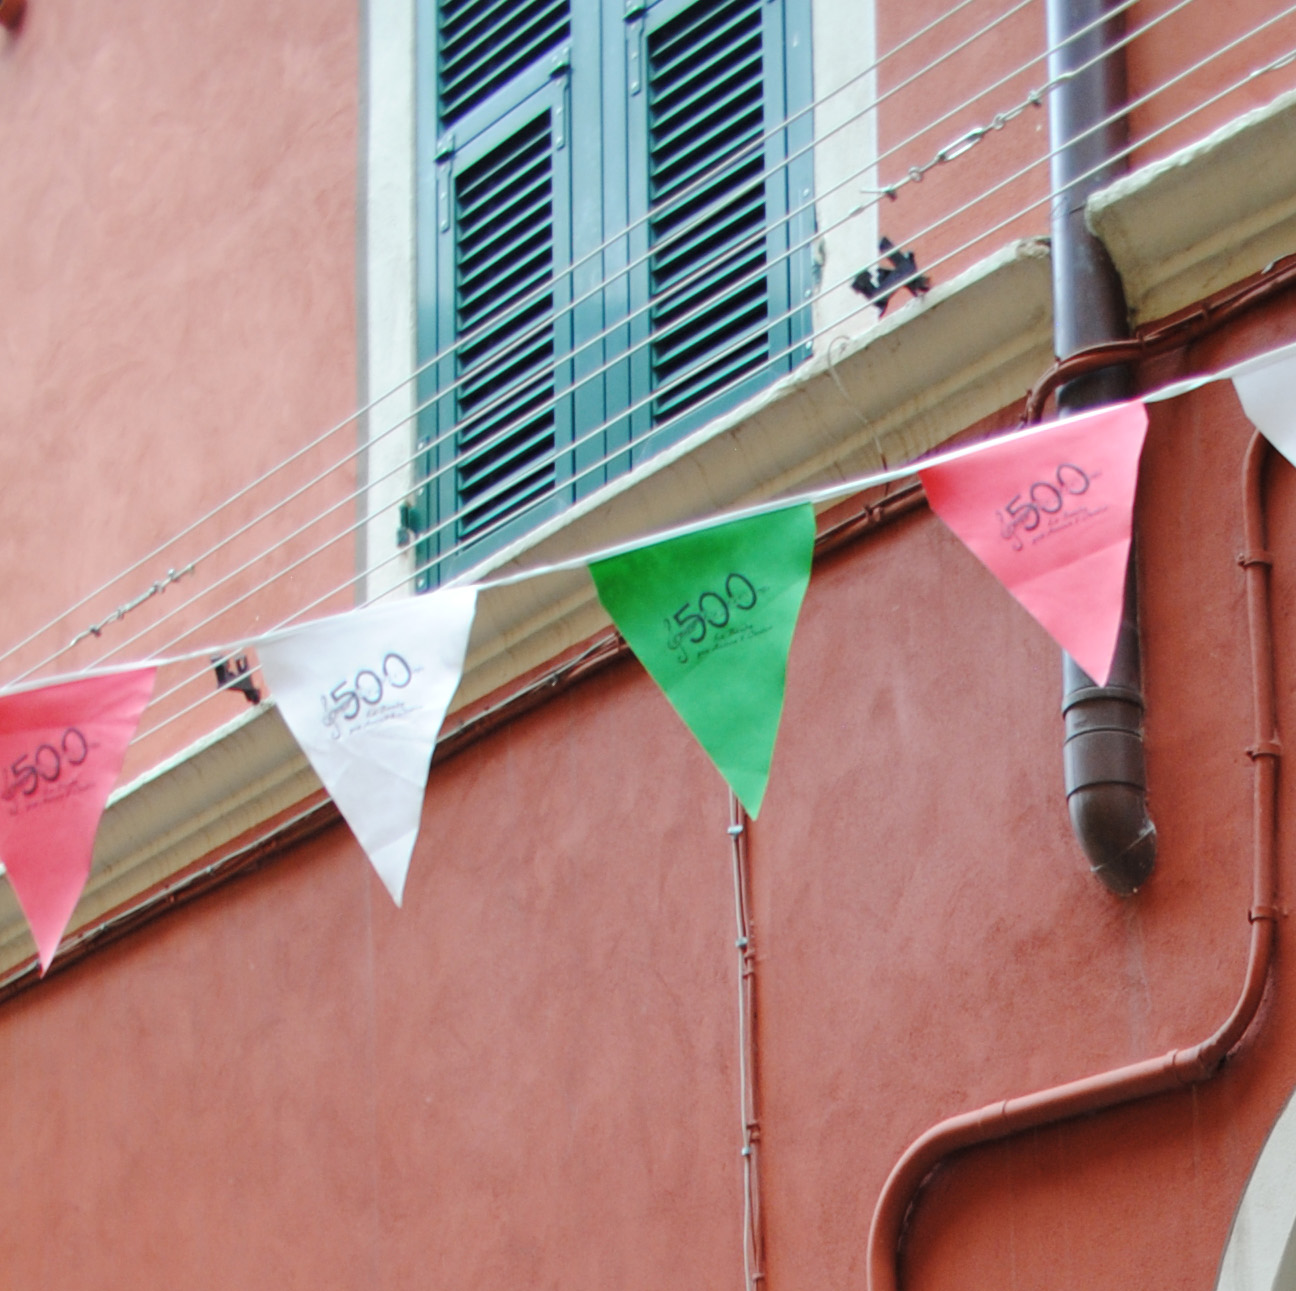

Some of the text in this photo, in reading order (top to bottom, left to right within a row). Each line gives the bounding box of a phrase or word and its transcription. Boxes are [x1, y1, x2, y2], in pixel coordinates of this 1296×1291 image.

[1006, 463, 1090, 531] 500
[674, 573, 757, 643] 500
[331, 653, 412, 720] 500
[11, 727, 88, 797] 500
